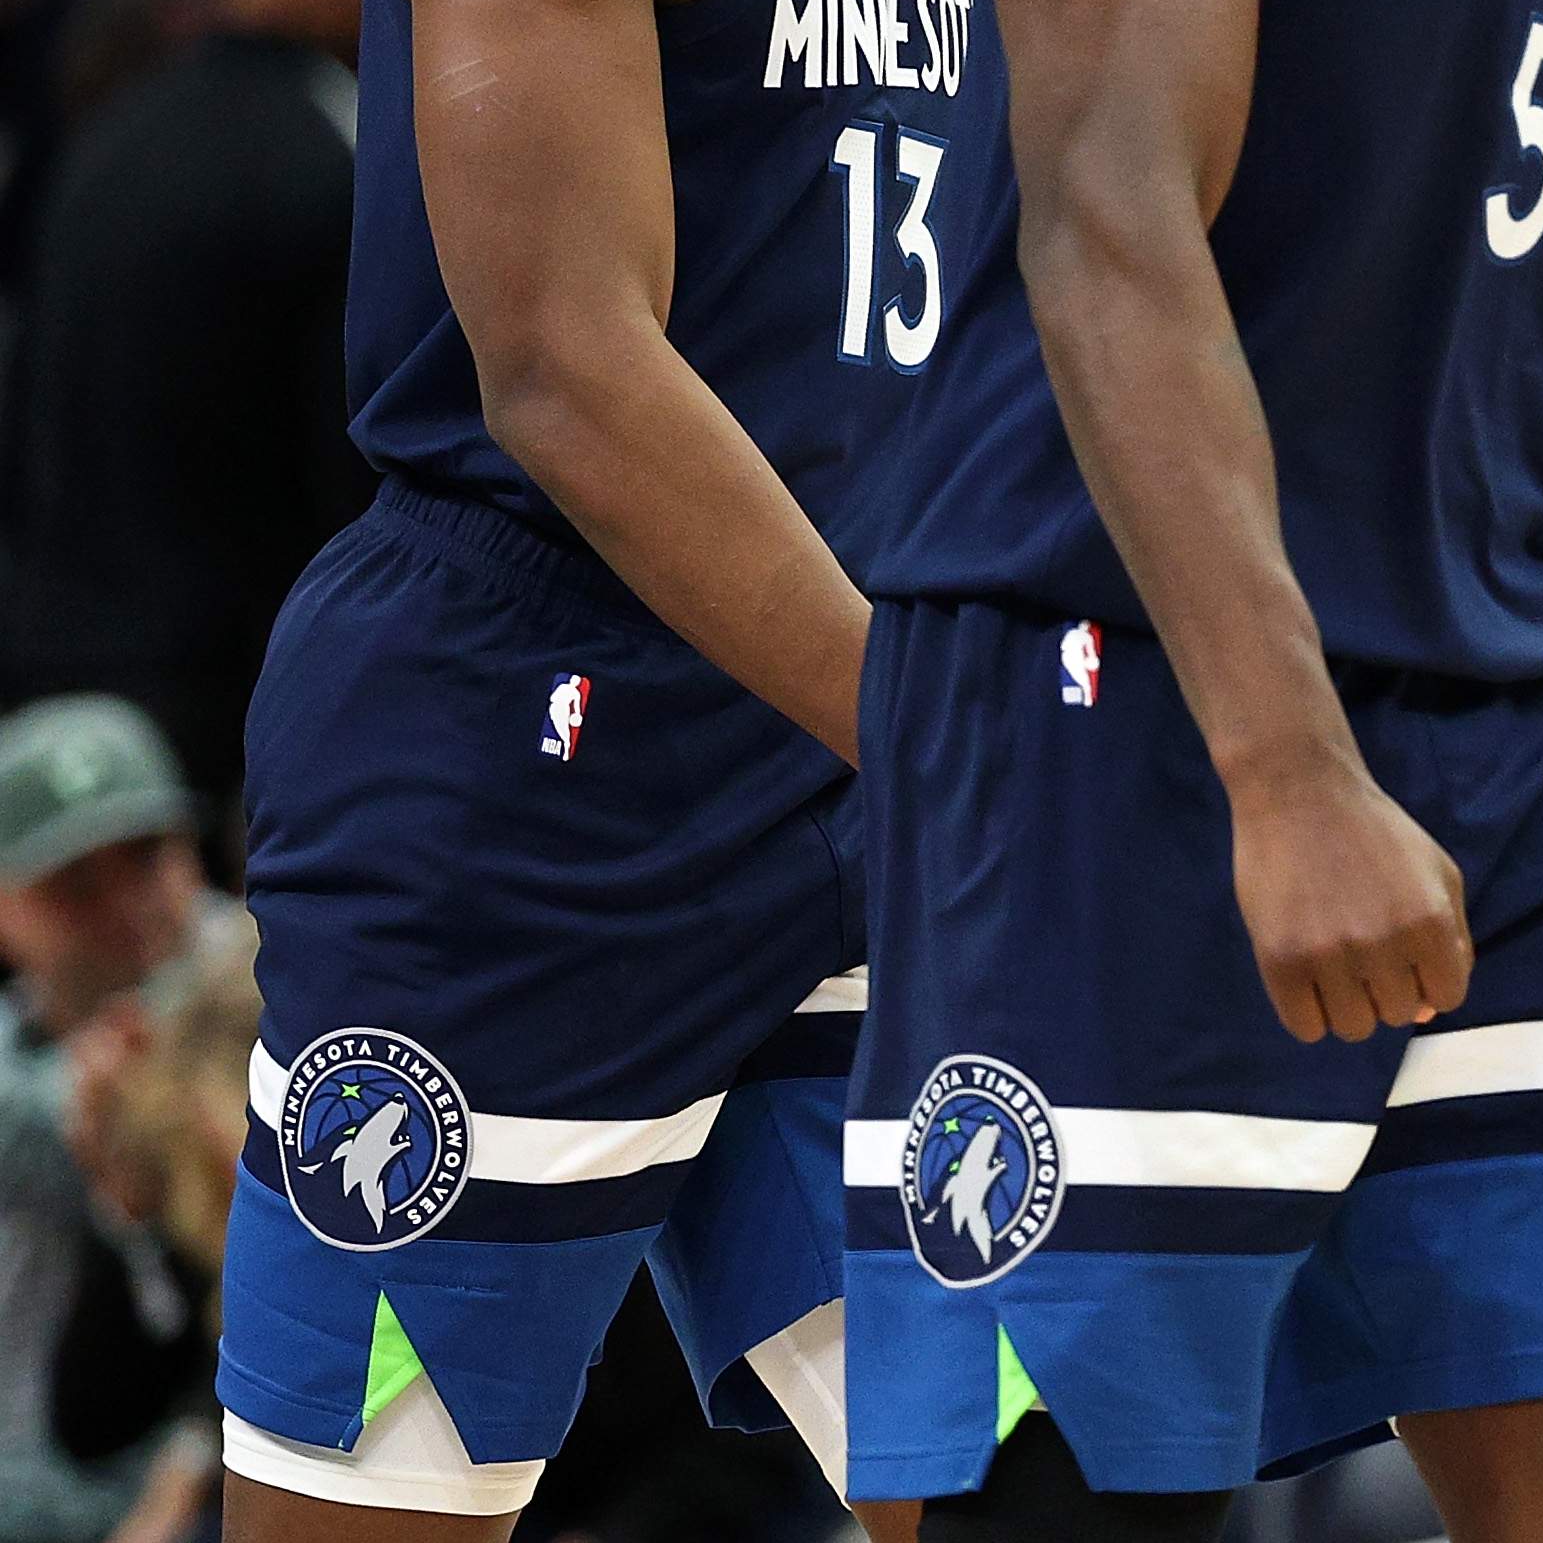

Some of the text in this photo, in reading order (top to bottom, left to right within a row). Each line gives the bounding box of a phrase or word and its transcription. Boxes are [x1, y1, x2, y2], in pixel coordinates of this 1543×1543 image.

[831, 122, 949, 371] 13
[284, 1040, 463, 1225] MINNESOTA TIMBERWOLVES
[904, 1067, 1056, 1248] MINNESOTA TIMBERWOLVES
